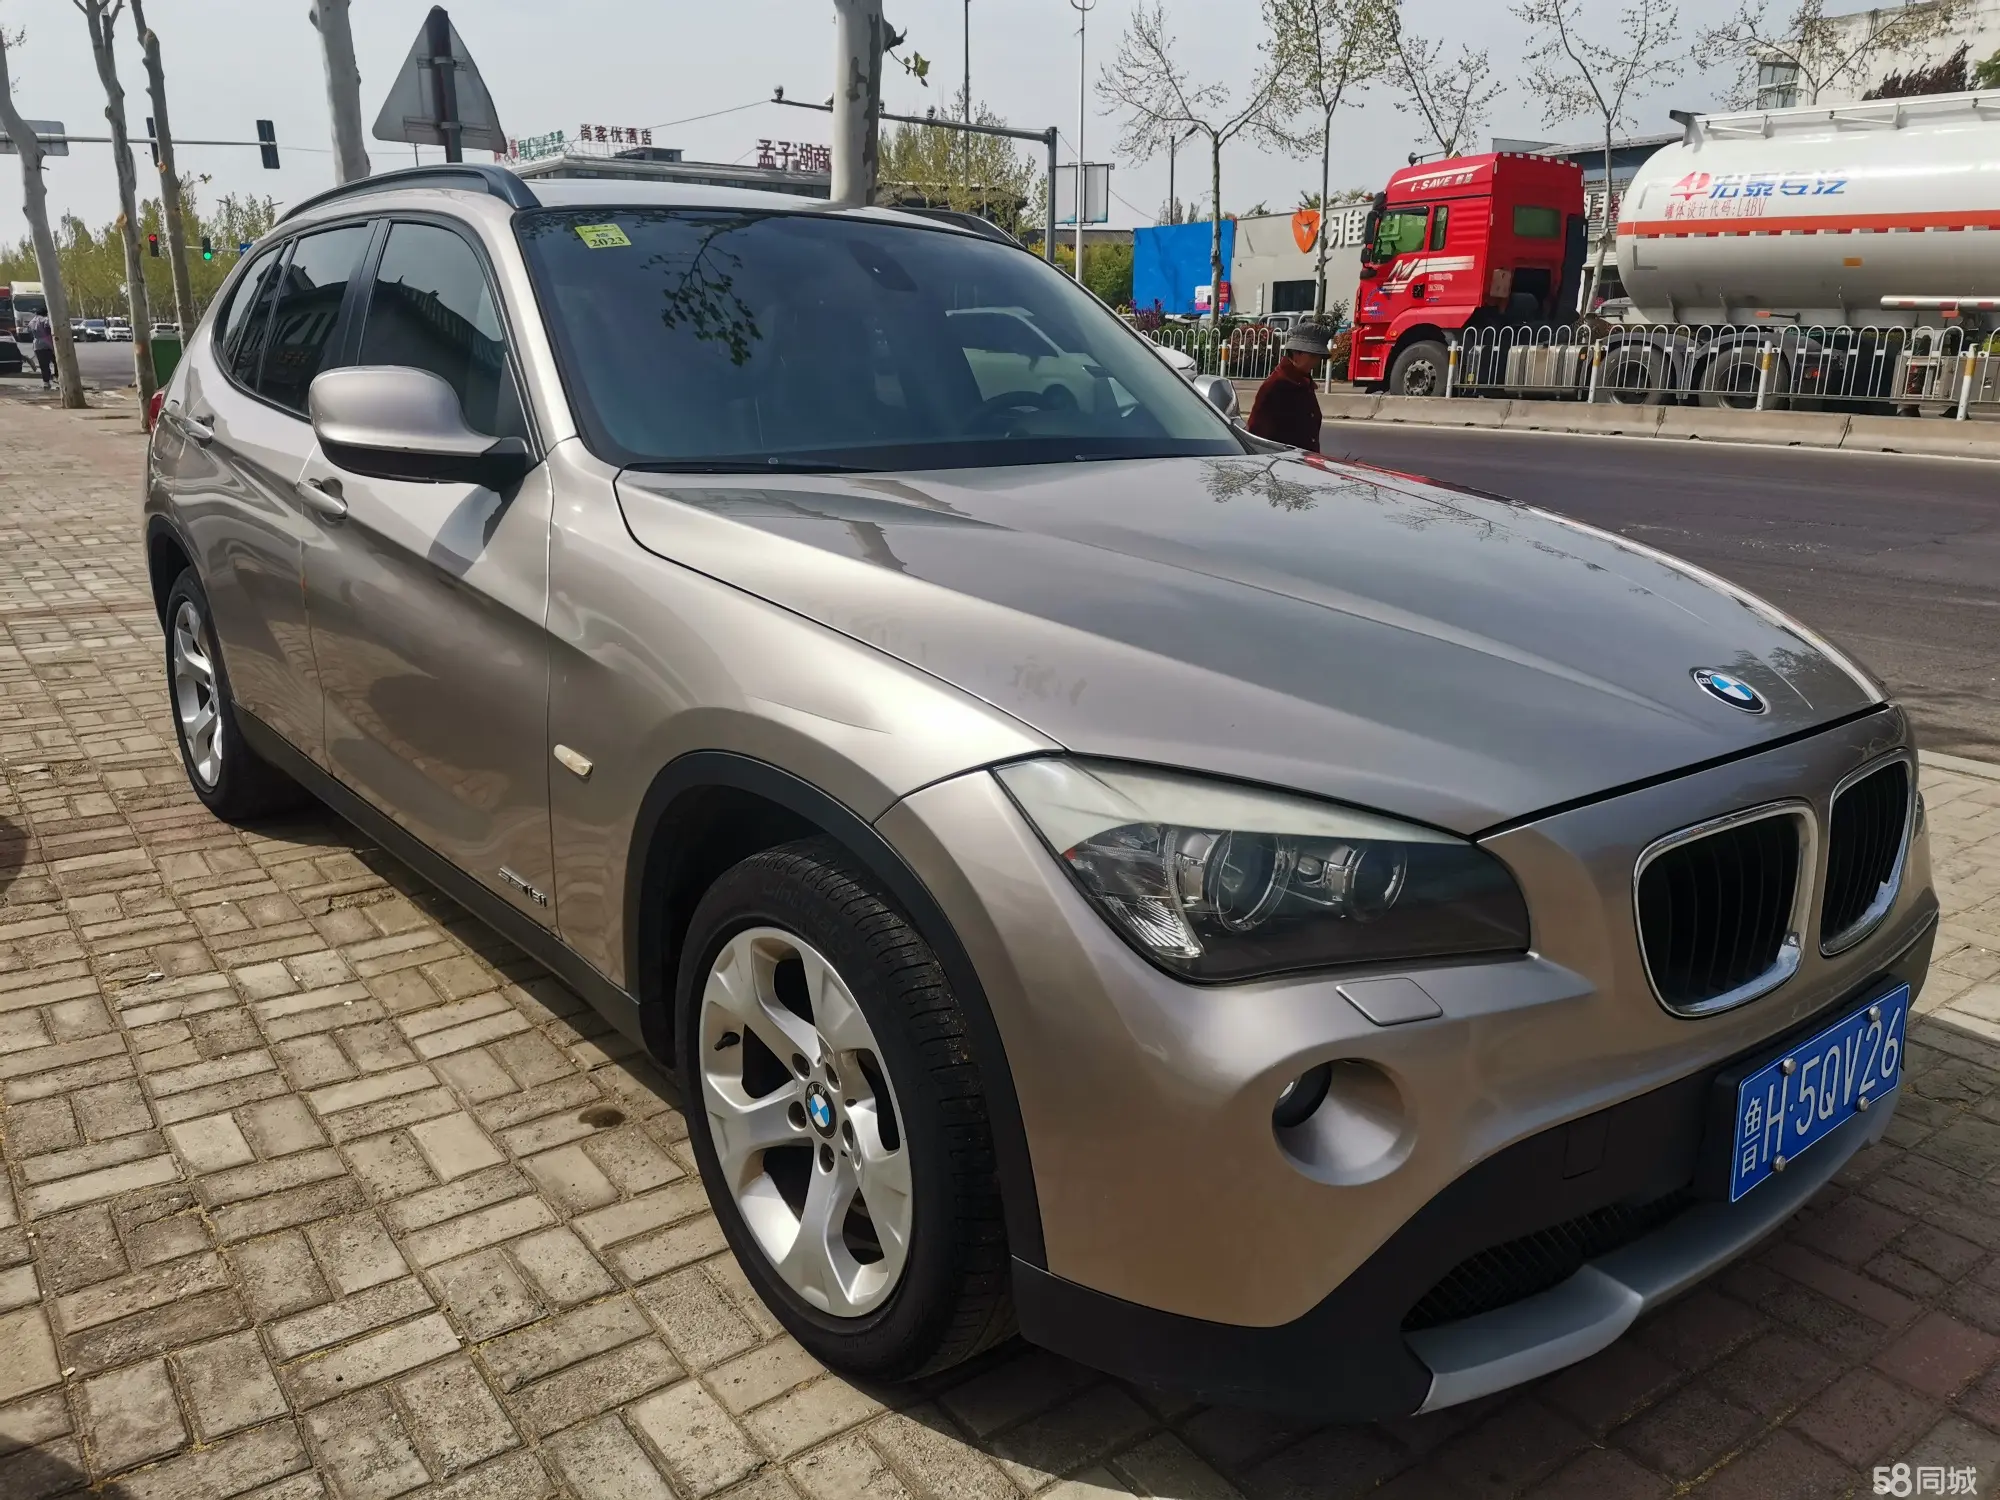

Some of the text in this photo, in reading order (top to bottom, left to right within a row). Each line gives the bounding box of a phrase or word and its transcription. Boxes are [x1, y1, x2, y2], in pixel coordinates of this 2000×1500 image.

[580, 124, 652, 146] 尚客优酒店
[1328, 210, 1365, 248] 雅
[590, 237, 625, 247] 2023
